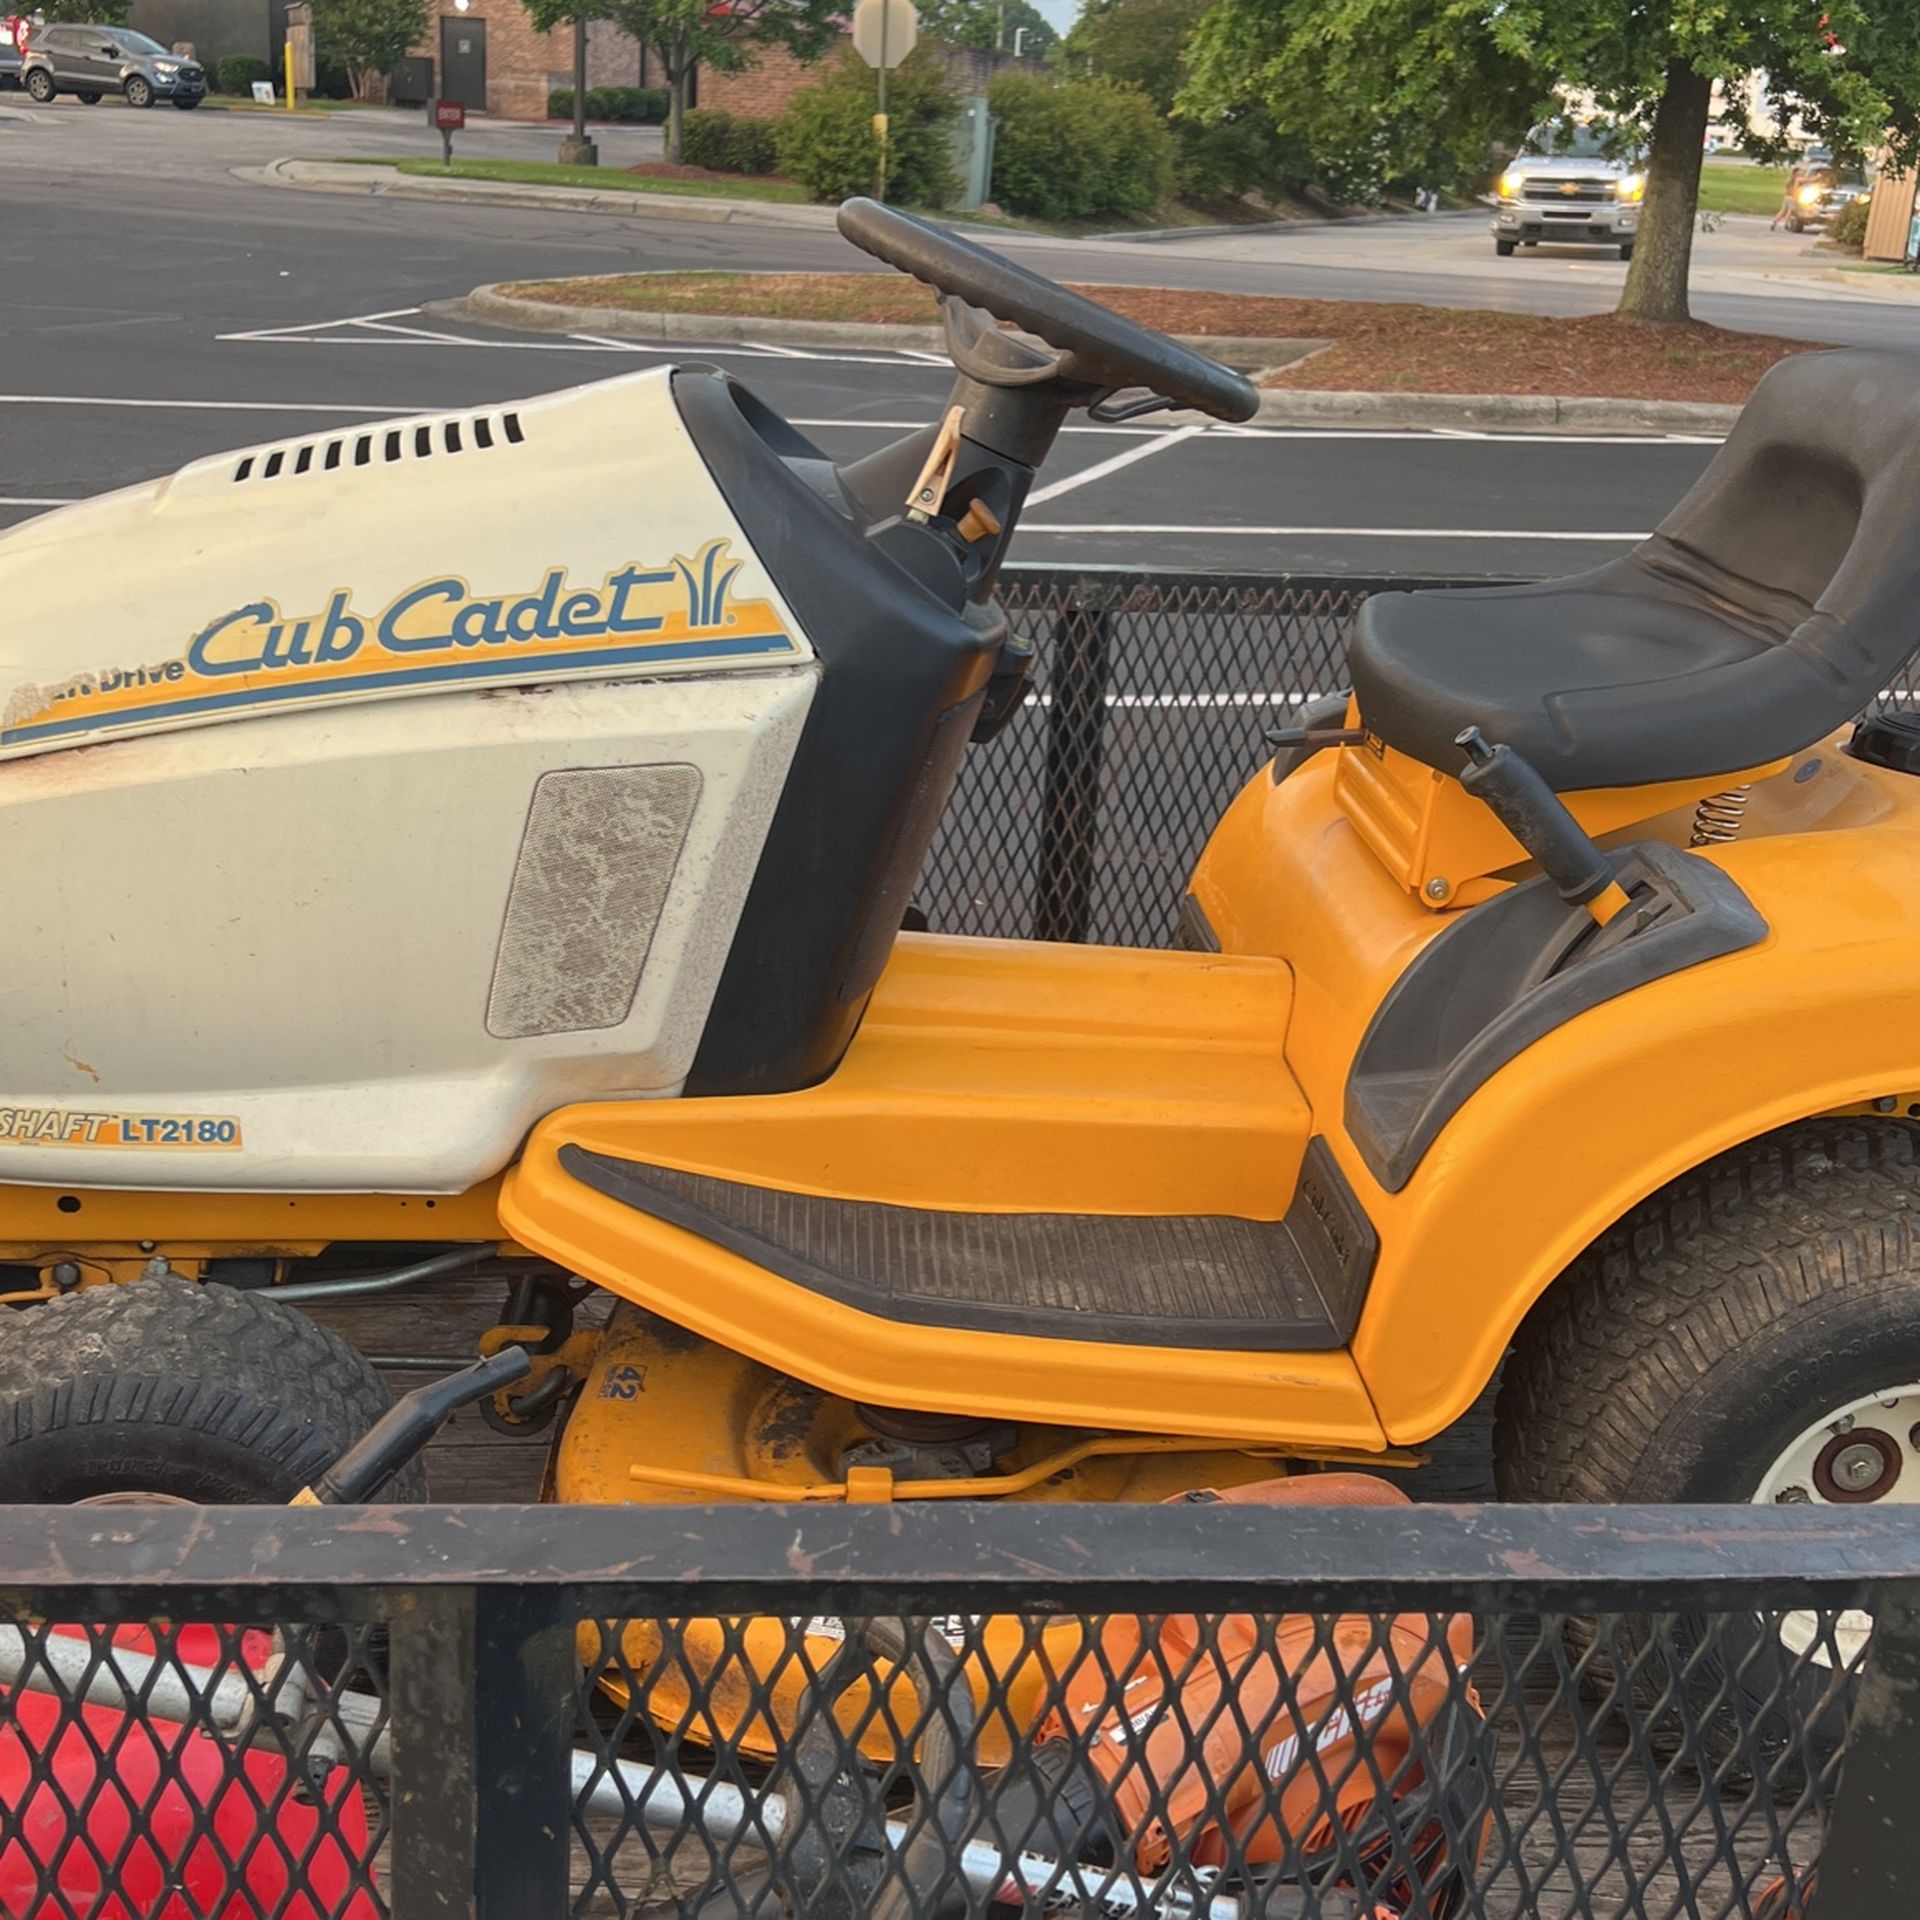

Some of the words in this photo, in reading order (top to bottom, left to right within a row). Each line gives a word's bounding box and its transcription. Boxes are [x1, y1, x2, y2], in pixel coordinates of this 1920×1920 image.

[188, 592, 365, 677] Cub
[378, 566, 677, 654] Cadet
[122, 1118, 236, 1143] LT2180
[609, 1366, 641, 1399] 42
